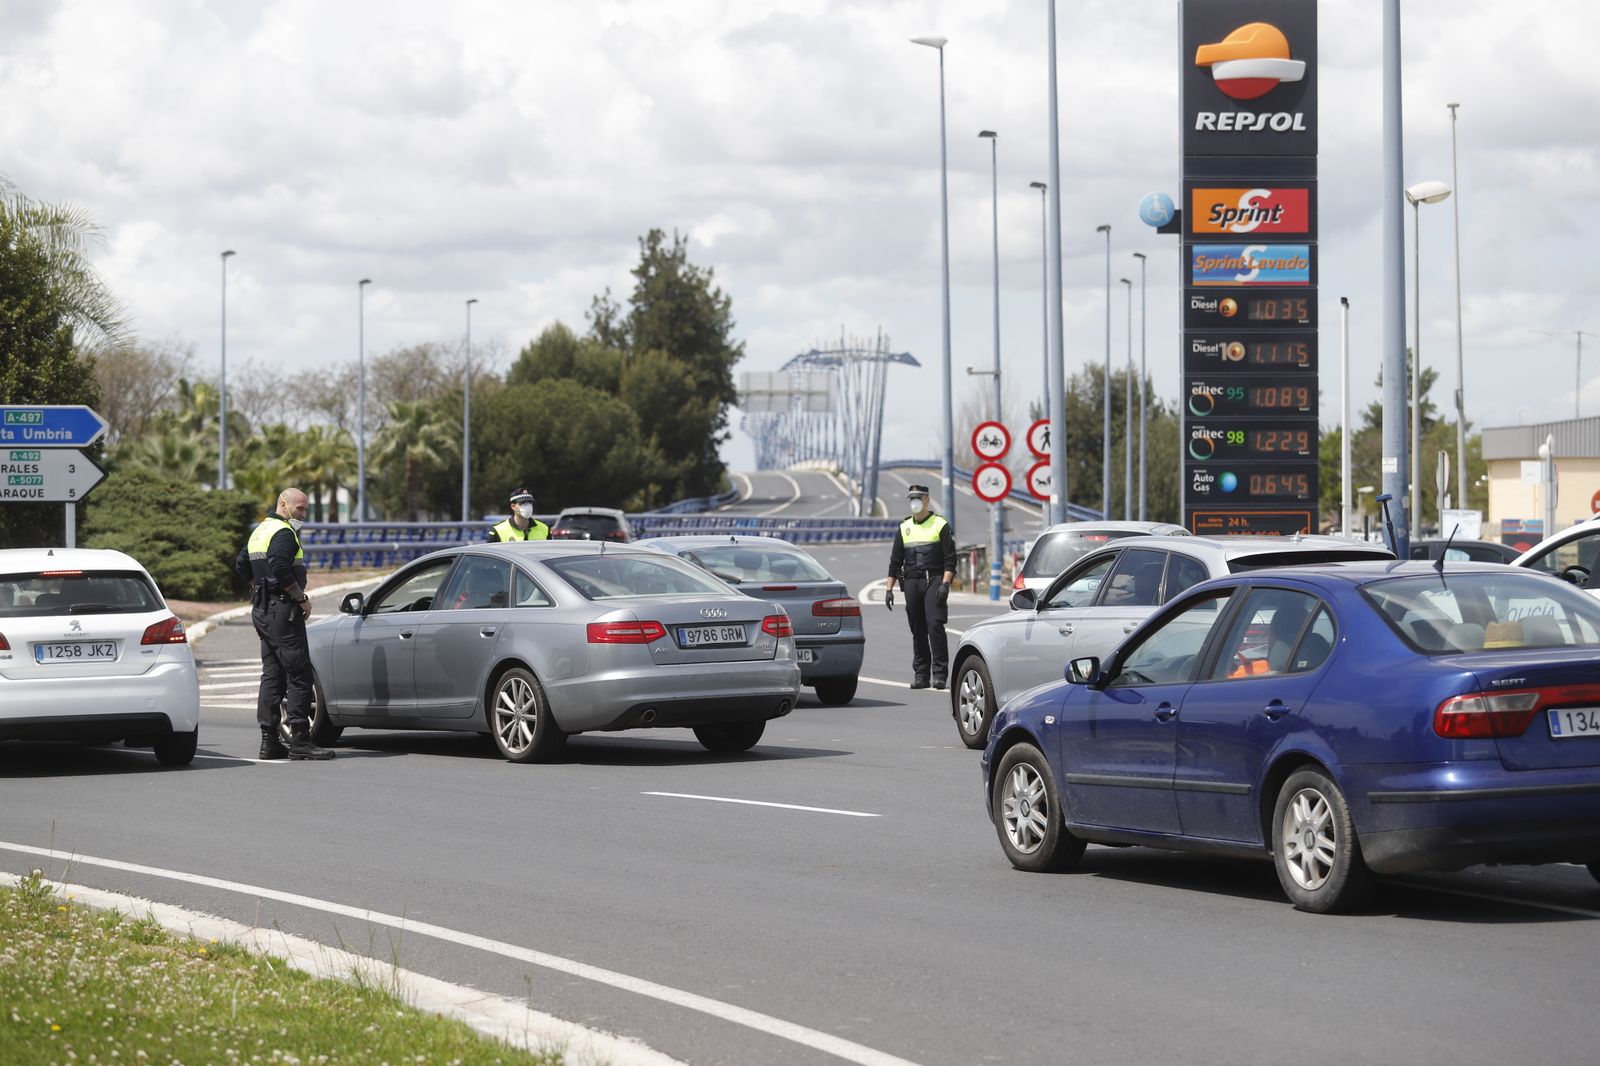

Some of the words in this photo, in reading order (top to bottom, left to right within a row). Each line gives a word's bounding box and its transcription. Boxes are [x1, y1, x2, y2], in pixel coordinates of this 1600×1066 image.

[1195, 112, 1307, 132] REPSOL
[1208, 201, 1285, 229] Sprint
[1193, 254, 1245, 273] Sprint
[1246, 255, 1308, 271] Lavado
[1191, 299, 1218, 309] Diesel
[1192, 343, 1219, 353] Diesel
[1191, 385, 1224, 395] efitec
[1226, 387, 1244, 400] 95
[7, 413, 41, 423] A-497
[23, 427, 73, 440] Umbría
[1191, 429, 1224, 439] efitec
[1226, 431, 1244, 444] 98
[11, 451, 40, 460] A-492
[1, 464, 39, 473] RALES
[68, 464, 76, 473] 3
[9, 476, 42, 484] A-5077
[1193, 473, 1214, 482] Auto
[1193, 482, 1210, 492] Gas
[0, 488, 45, 498] RAQUE
[69, 489, 76, 498] 5
[1228, 518, 1239, 527] 24
[687, 626, 718, 643] 9786
[720, 624, 744, 643] GRM
[48, 645, 82, 658] 1258
[87, 644, 114, 657] JKZ
[1565, 711, 1600, 733] 134
